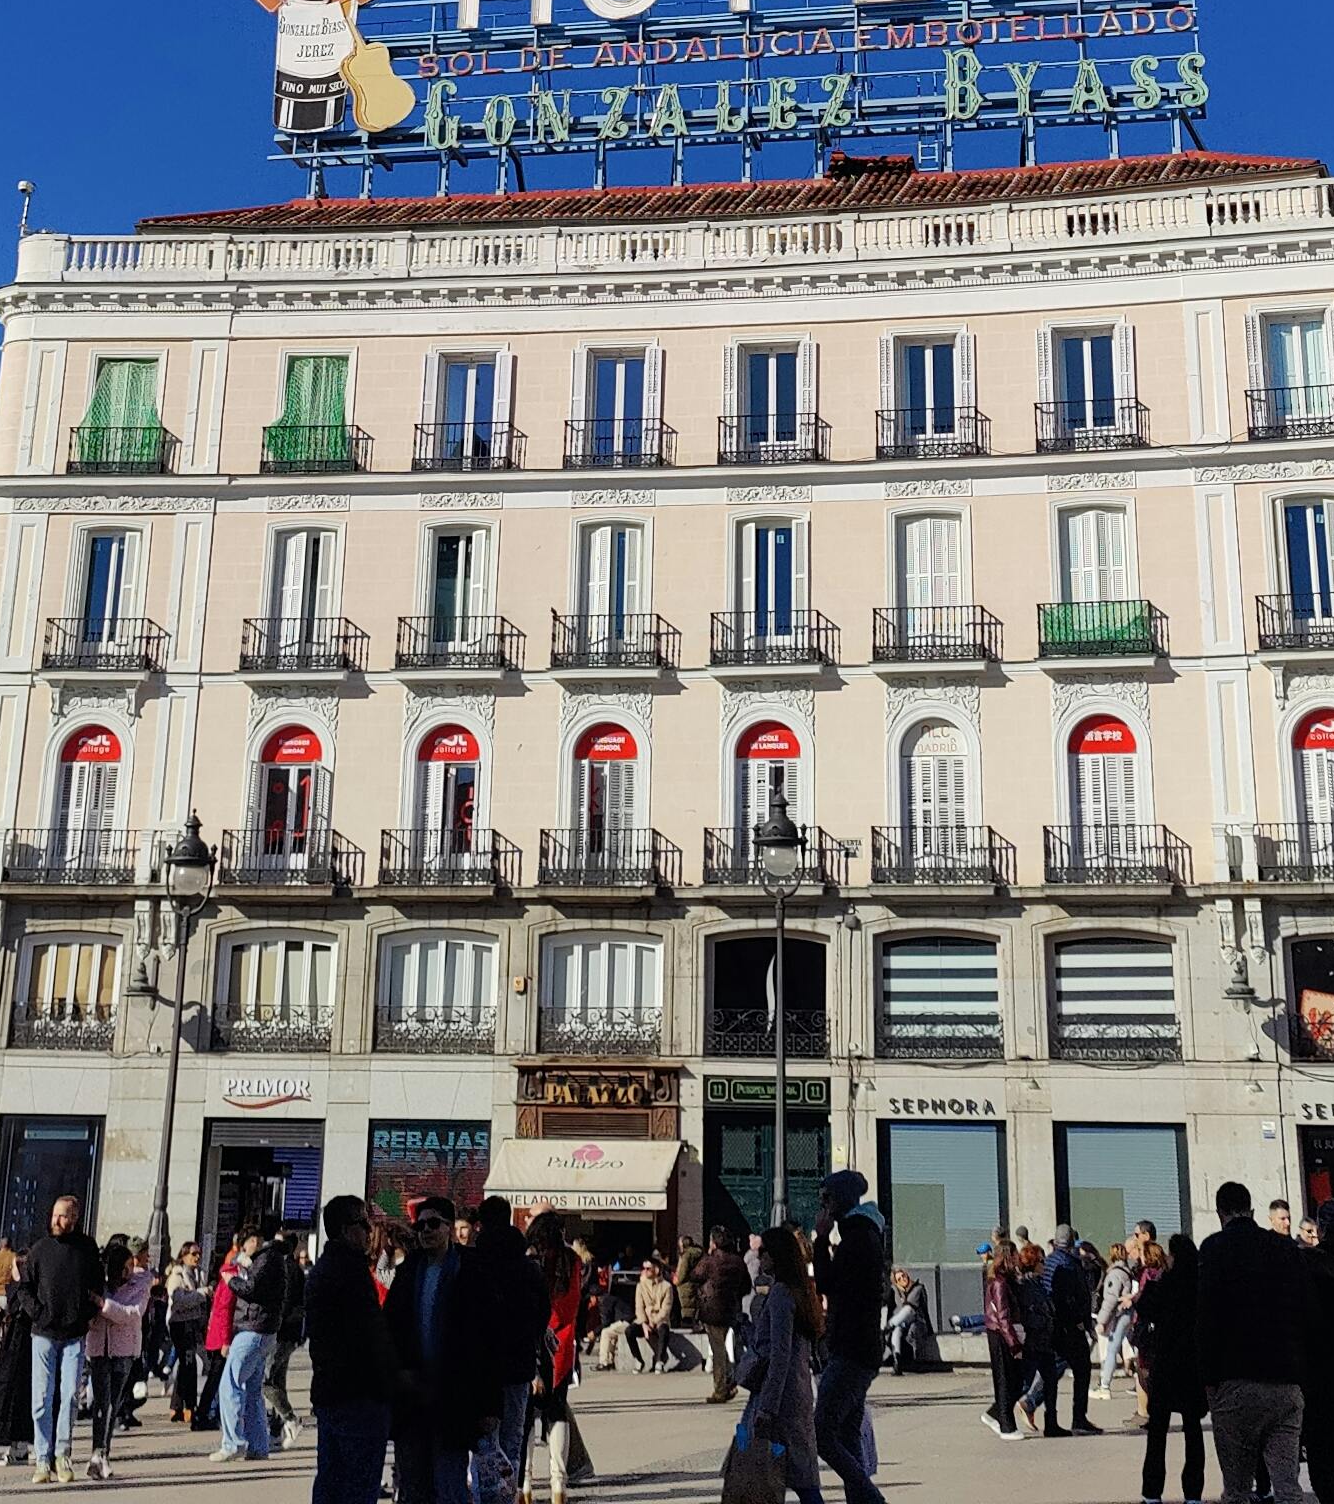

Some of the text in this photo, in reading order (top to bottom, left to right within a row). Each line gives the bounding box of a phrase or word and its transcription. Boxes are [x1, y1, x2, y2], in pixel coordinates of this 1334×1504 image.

[279, 15, 320, 37] GONZALEZ
[419, 6, 1195, 78] SOL DE ANDALUCIA EMBOTELLADO
[297, 43, 335, 58] JEREZ
[281, 80, 304, 94] FINO
[308, 83, 327, 94] MUY
[424, 48, 1210, 151] GONZALEZ BYASS
[434, 745, 468, 755] college
[594, 744, 622, 752] SCHOOL
[224, 1078, 312, 1097] PRIMOR
[713, 1084, 724, 1096] 11
[810, 1085, 822, 1098] 11
[889, 1097, 996, 1116] SEPHORA
[372, 1130, 489, 1150] REBAJAS
[1314, 1139, 1323, 1150] EL
[547, 1156, 624, 1170] Palazzo
[505, 1195, 647, 1207] HELADOS ITALIANOS
